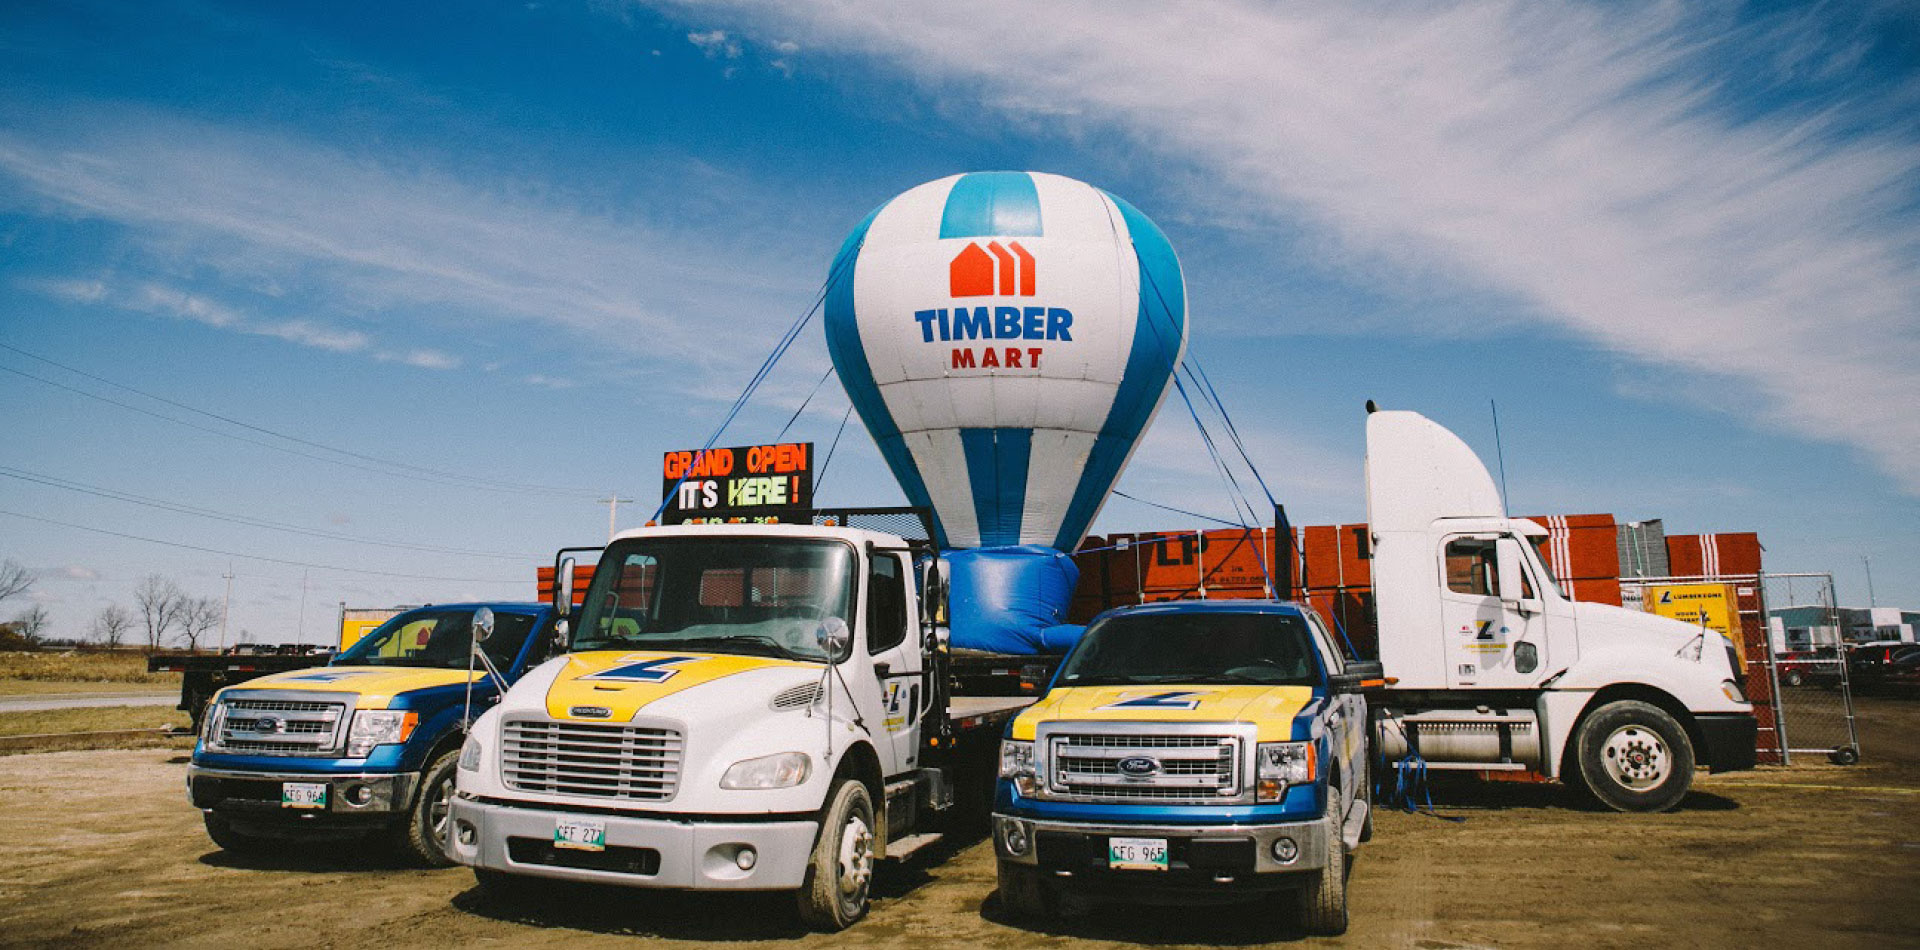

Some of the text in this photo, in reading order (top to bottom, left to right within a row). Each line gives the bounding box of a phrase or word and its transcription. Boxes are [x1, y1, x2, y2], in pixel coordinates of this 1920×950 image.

[914, 306, 1074, 343] TIMBER
[951, 347, 1043, 370] MART
[663, 443, 807, 479] GRAND OPEN
[678, 479, 719, 511] IT'S
[1155, 533, 1209, 566] LP
[1112, 845, 1165, 862] CFG 965
